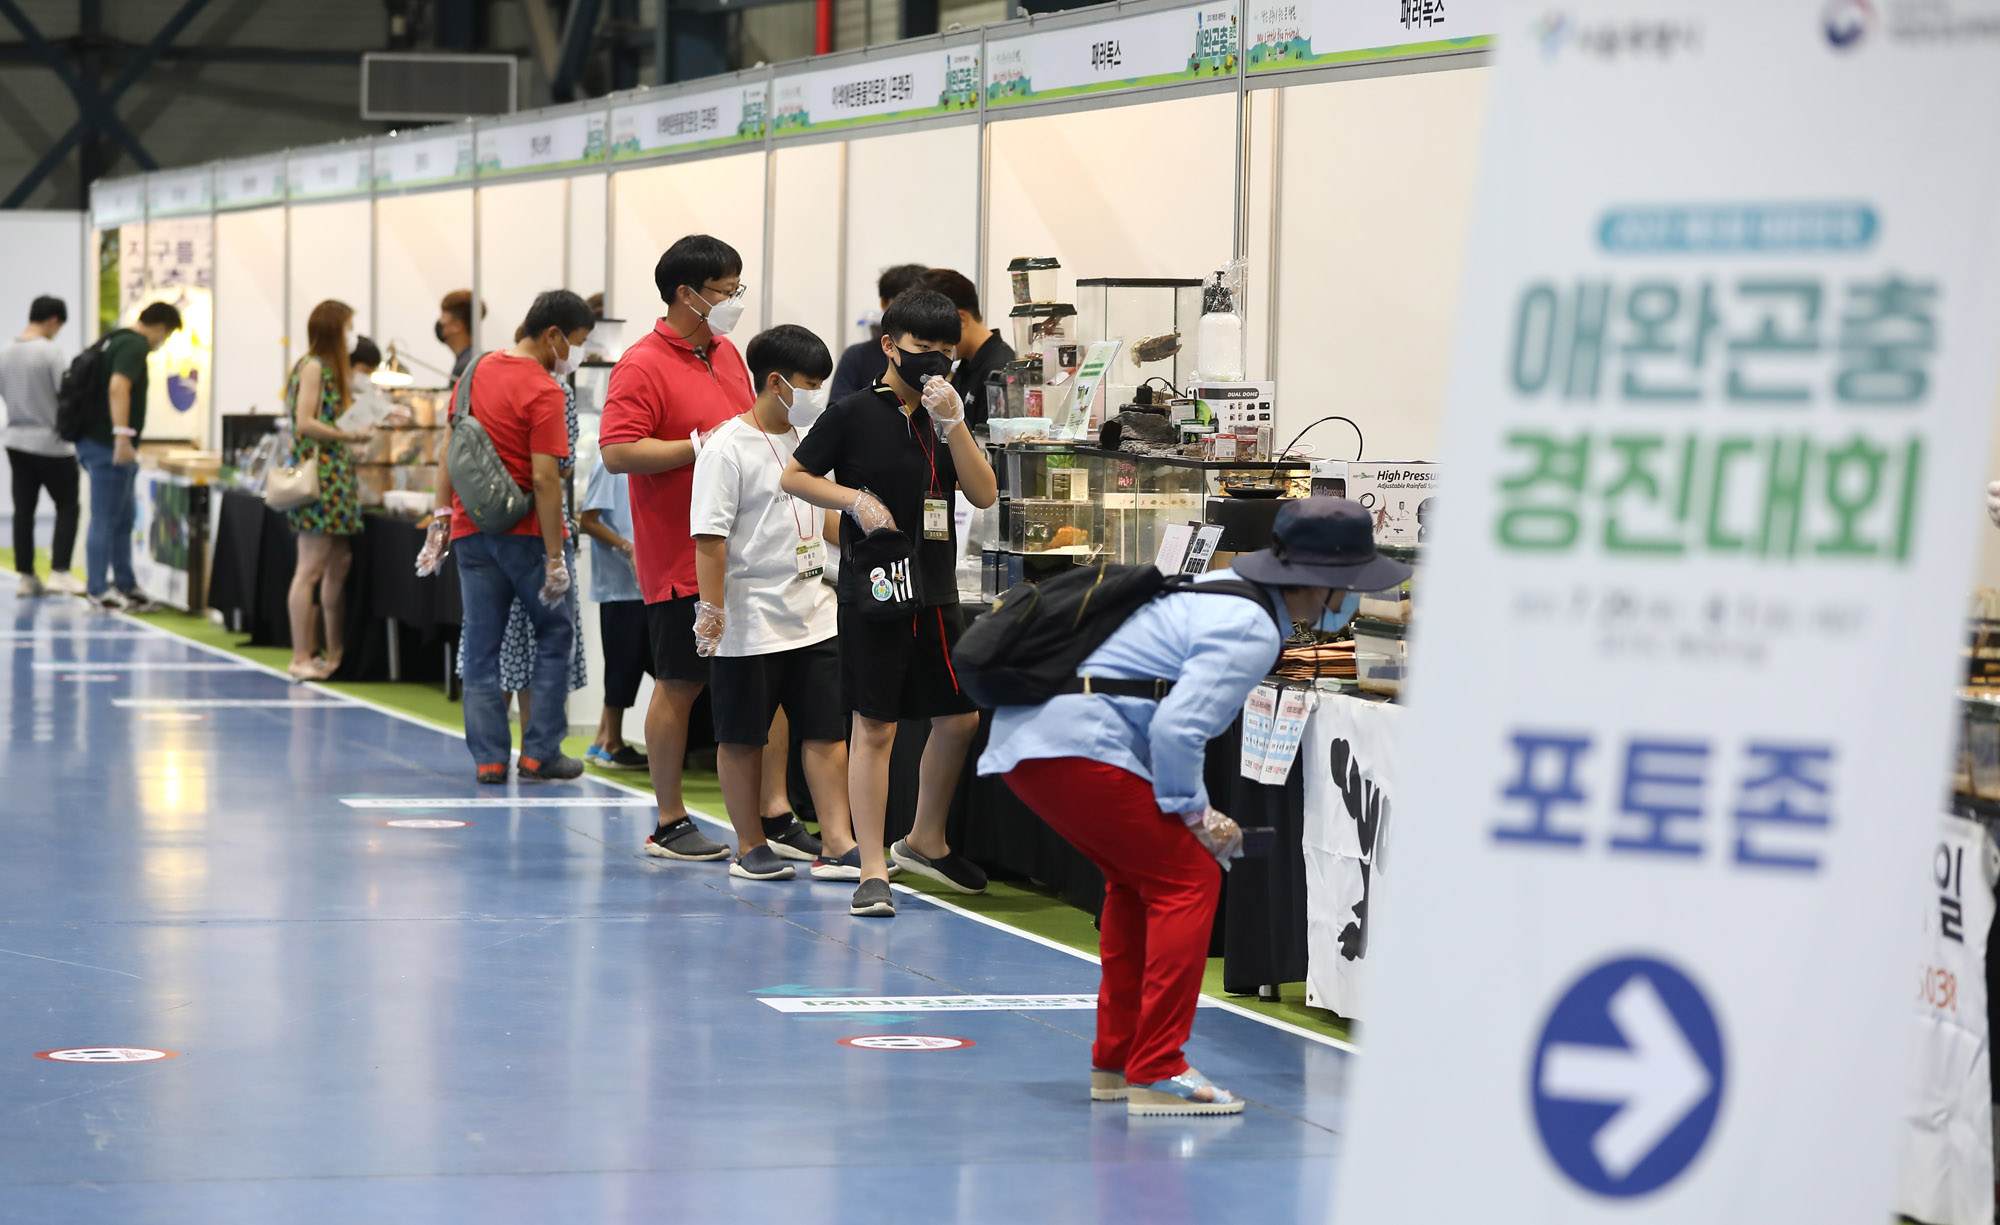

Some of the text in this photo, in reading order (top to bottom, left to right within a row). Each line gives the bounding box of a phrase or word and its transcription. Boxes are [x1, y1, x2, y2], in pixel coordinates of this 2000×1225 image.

[1092, 40, 1122, 70] 패러독스
[1400, 0, 1445, 30] 패러독스
[1512, 272, 1940, 403] 애완곤충
[1377, 470, 1401, 482] High
[1403, 470, 1441, 481] Pressu
[1494, 430, 1925, 564] 경진대회
[1490, 731, 1837, 873] 포토존
